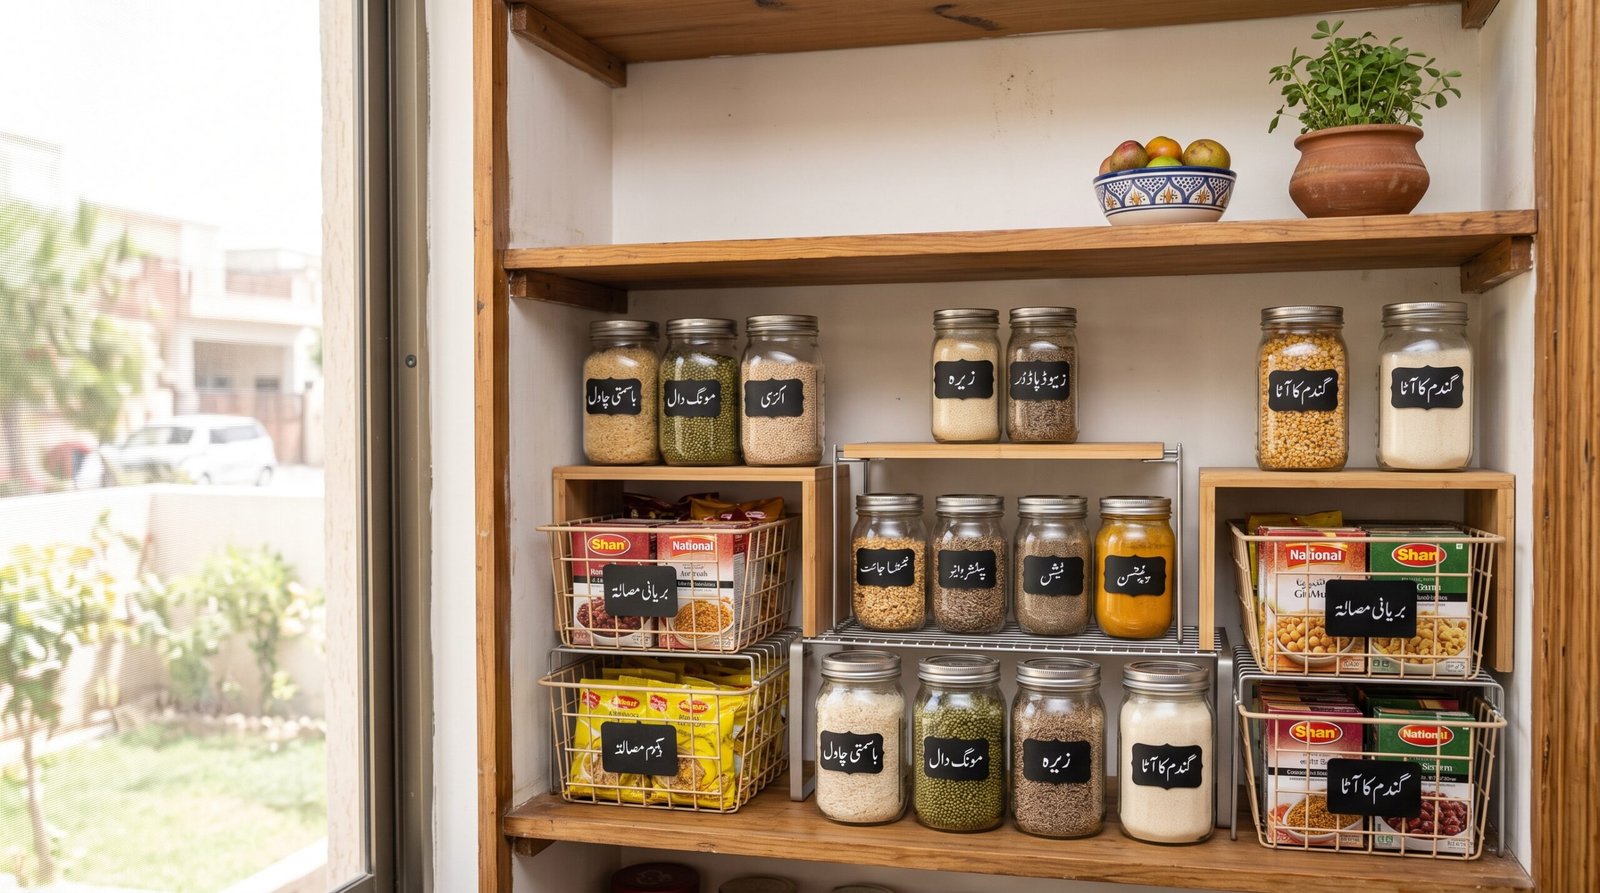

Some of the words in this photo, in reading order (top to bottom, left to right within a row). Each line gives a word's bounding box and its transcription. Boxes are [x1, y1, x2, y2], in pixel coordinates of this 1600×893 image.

[611, 386, 637, 407] باسمتی
[686, 387, 716, 406] مونگ
[1292, 380, 1305, 399] کا
[1300, 377, 1333, 406] گندم
[1400, 377, 1418, 396] آٹا
[1418, 378, 1431, 396] کا
[1427, 374, 1459, 404] گندم
[588, 387, 610, 410] چاول
[667, 389, 686, 408] دال
[591, 538, 626, 551] Shan
[672, 541, 714, 551] National
[1290, 549, 1342, 561] National
[1397, 548, 1439, 562] Shan
[641, 581, 669, 603] بریانی
[1371, 597, 1407, 623] بریانی
[1295, 725, 1337, 739] Shan
[823, 740, 849, 767] چاول
[849, 739, 878, 765] باسمتی
[928, 749, 951, 769] دال
[951, 748, 983, 769] مونگ
[1141, 756, 1159, 774] آٹا
[1158, 758, 1171, 775] کا
[1166, 754, 1197, 783] گندم
[1340, 773, 1363, 796] آٹا
[1362, 777, 1377, 797] کا
[1372, 773, 1412, 806] گندم
